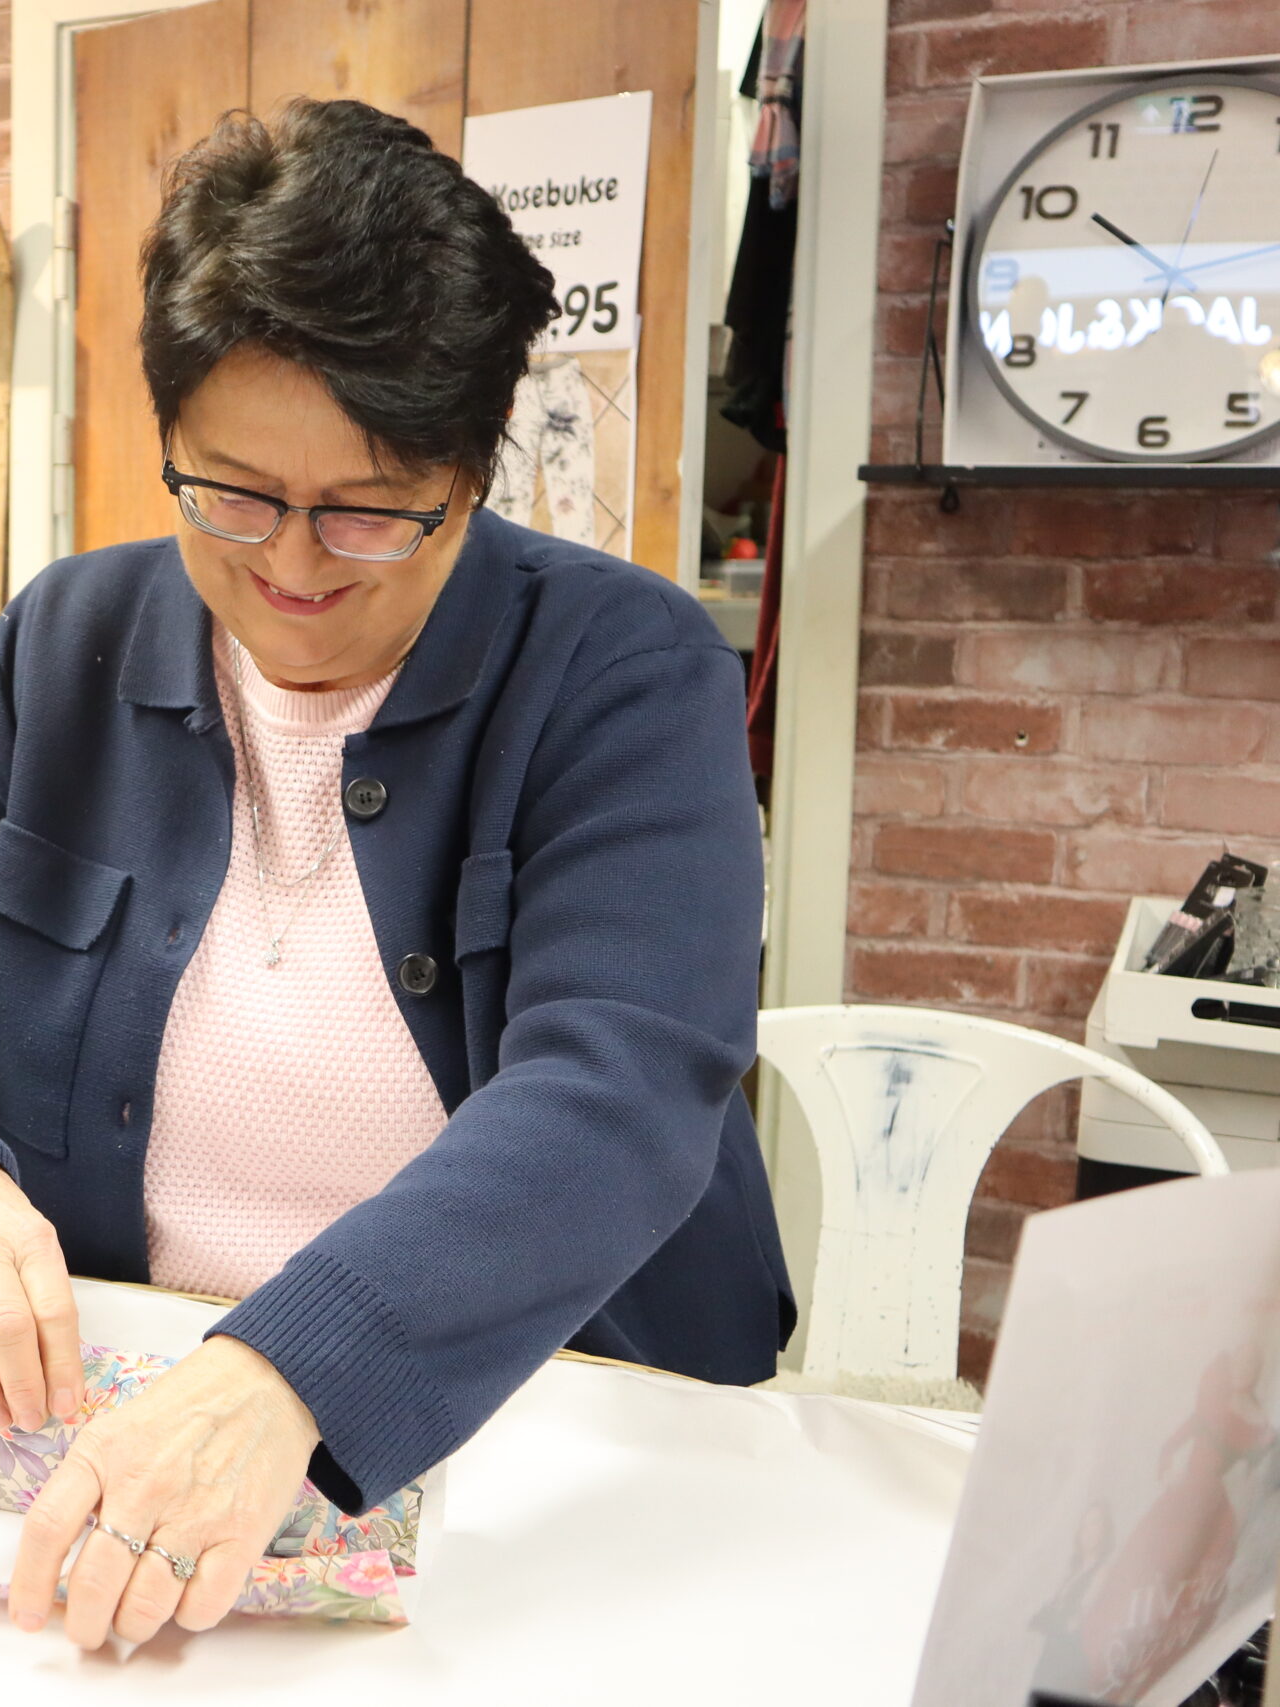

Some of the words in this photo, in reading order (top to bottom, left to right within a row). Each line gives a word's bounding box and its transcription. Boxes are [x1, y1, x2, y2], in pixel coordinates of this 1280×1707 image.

[1170, 95, 1223, 133] 12
[1088, 123, 1120, 158] 11
[492, 175, 618, 212] Kosebukse
[1020, 185, 1078, 220] 10
[550, 229, 581, 248] size
[1004, 335, 1036, 368] 8
[1060, 391, 1091, 424] 7
[1224, 392, 1261, 428] 5
[1137, 416, 1171, 448] 6
